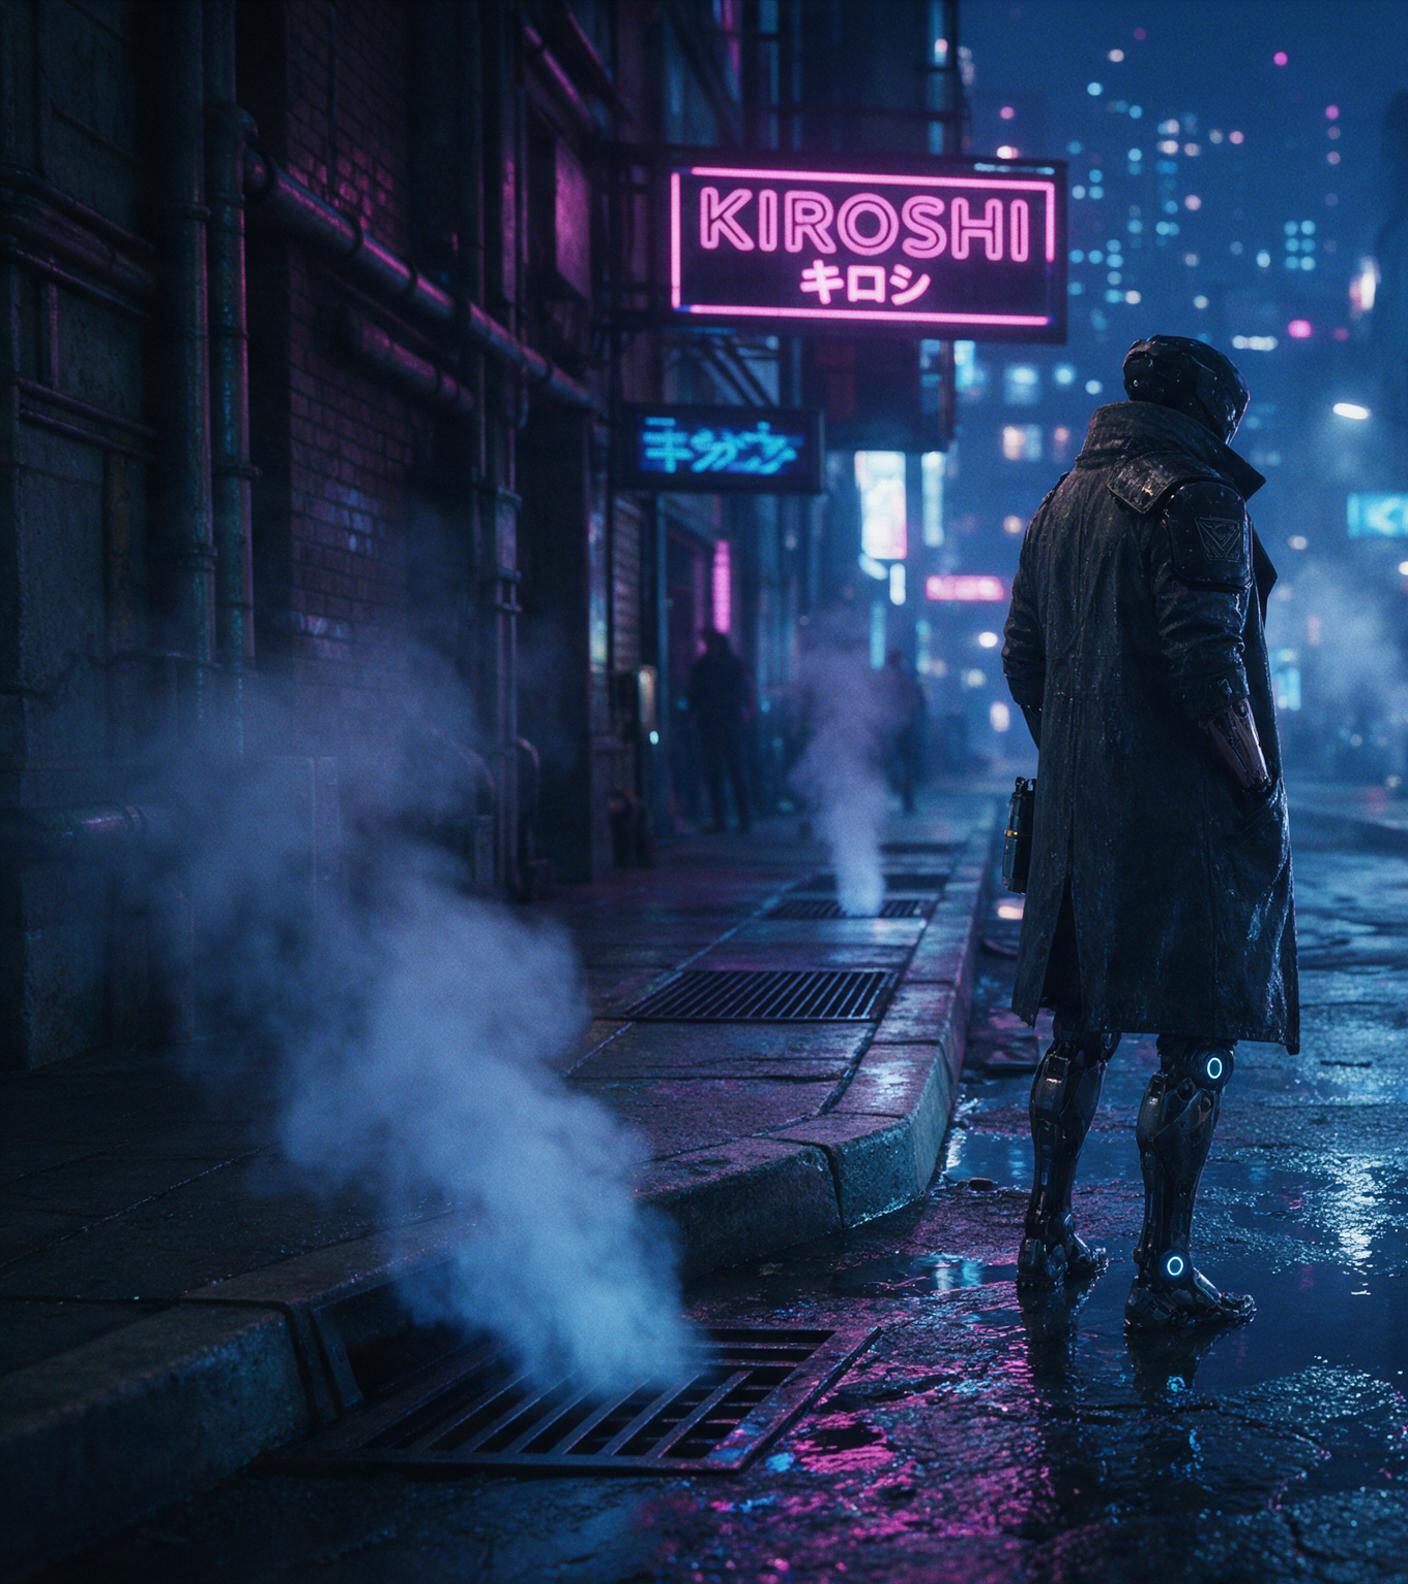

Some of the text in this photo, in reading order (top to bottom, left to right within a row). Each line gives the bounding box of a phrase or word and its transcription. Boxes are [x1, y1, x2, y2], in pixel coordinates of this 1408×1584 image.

[700, 186, 1029, 262] KIROSHI
[800, 259, 931, 305] キロシ
